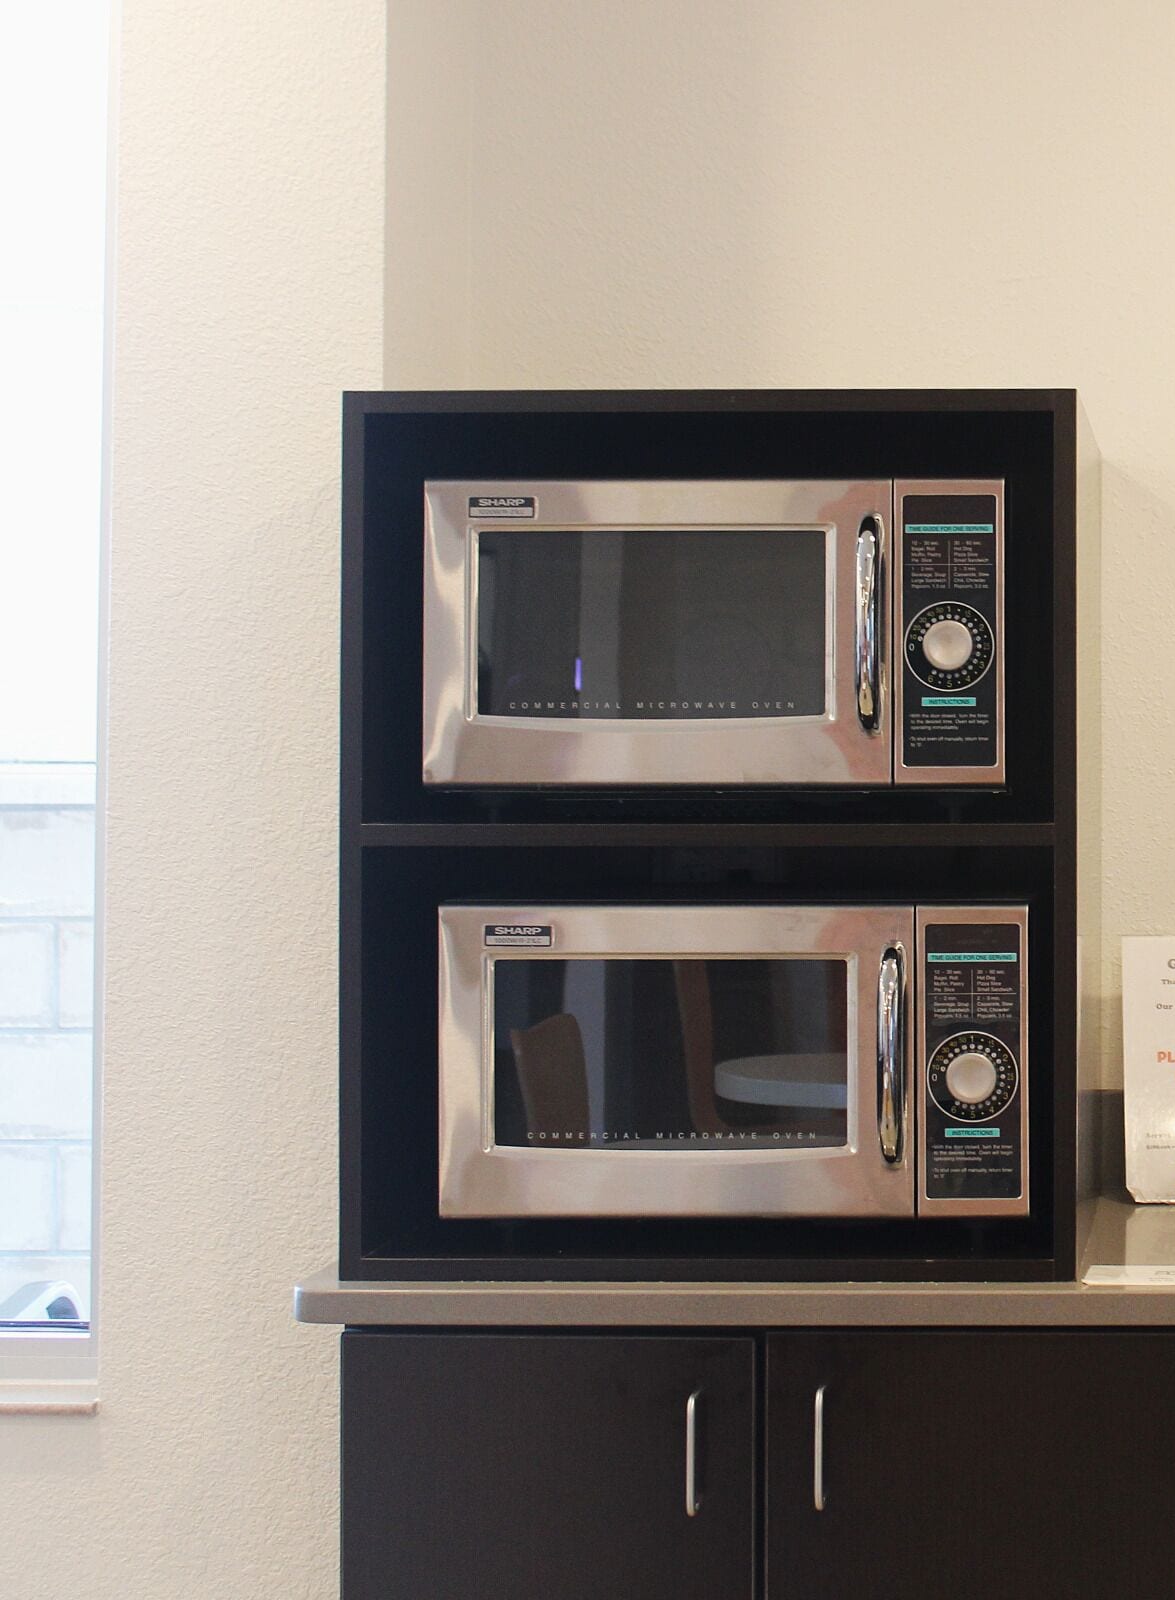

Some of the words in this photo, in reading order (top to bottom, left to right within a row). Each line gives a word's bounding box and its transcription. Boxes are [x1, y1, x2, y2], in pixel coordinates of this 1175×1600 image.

[478, 498, 525, 507] SHARP
[979, 624, 985, 632] 2
[908, 643, 915, 652] 0
[979, 661, 985, 669] 3
[928, 675, 934, 683] 6
[947, 680, 952, 688] 5
[494, 926, 542, 935] SHARP
[970, 1035, 974, 1043] 1
[1002, 1054, 1009, 1062] 2
[931, 1073, 938, 1082] 0
[1003, 1092, 1009, 1100] 3
[951, 1106, 957, 1114] 6
[969, 1111, 976, 1119] 5
